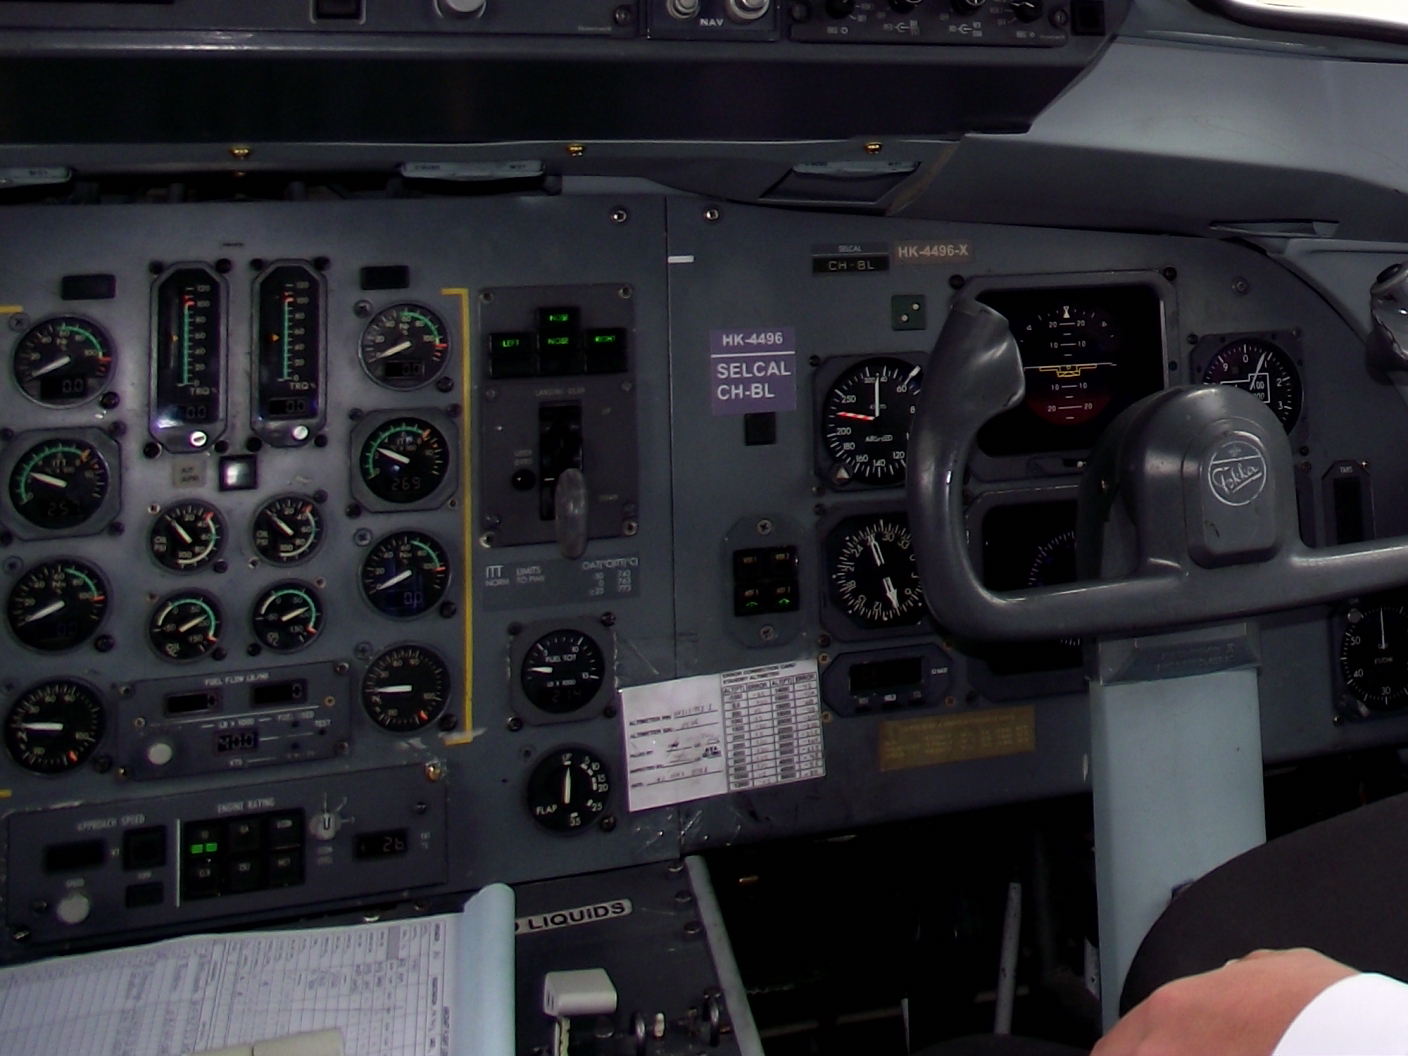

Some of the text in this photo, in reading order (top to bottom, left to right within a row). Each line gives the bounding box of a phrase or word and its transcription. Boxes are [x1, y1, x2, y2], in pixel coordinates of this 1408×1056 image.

[700, 18, 724, 27] NAV
[838, 245, 862, 253] SELCAL
[898, 244, 968, 258] HK-4496-X
[549, 314, 569, 322] NOSE
[1048, 319, 1086, 329] 20 20
[502, 339, 520, 348] LEFT
[547, 337, 569, 345] NOSE
[722, 332, 783, 346] HK-4496
[1050, 340, 1087, 349] 10 10
[1242, 354, 1249, 363] 0
[717, 361, 791, 379] SELCAL
[1222, 362, 1229, 372] 9
[289, 381, 310, 390] TRQ
[1051, 382, 1088, 391] 10 10
[1276, 377, 1282, 387] 2
[717, 383, 776, 400] CH-BL
[841, 395, 857, 404] 250
[910, 405, 916, 414] 8
[1047, 402, 1093, 413] 20 20
[1278, 400, 1283, 410] 3
[836, 427, 852, 436] 200
[843, 442, 856, 451] 180
[856, 454, 869, 463] 160
[893, 451, 906, 460] 120
[872, 459, 886, 467] 140
[1350, 635, 1361, 646] 50
[545, 655, 561, 663] FUEL
[1353, 668, 1364, 678] 40
[205, 678, 223, 686] FUEL
[225, 675, 245, 684] FLOW
[1380, 686, 1391, 696] 30
[562, 753, 573, 761] UP
[592, 762, 600, 771] 10
[598, 783, 609, 792] 20
[217, 797, 275, 813] ENGINE RATING
[536, 805, 558, 816] FLAP
[121, 813, 146, 826] SPEED
[528, 901, 626, 931] LIQUIDS
